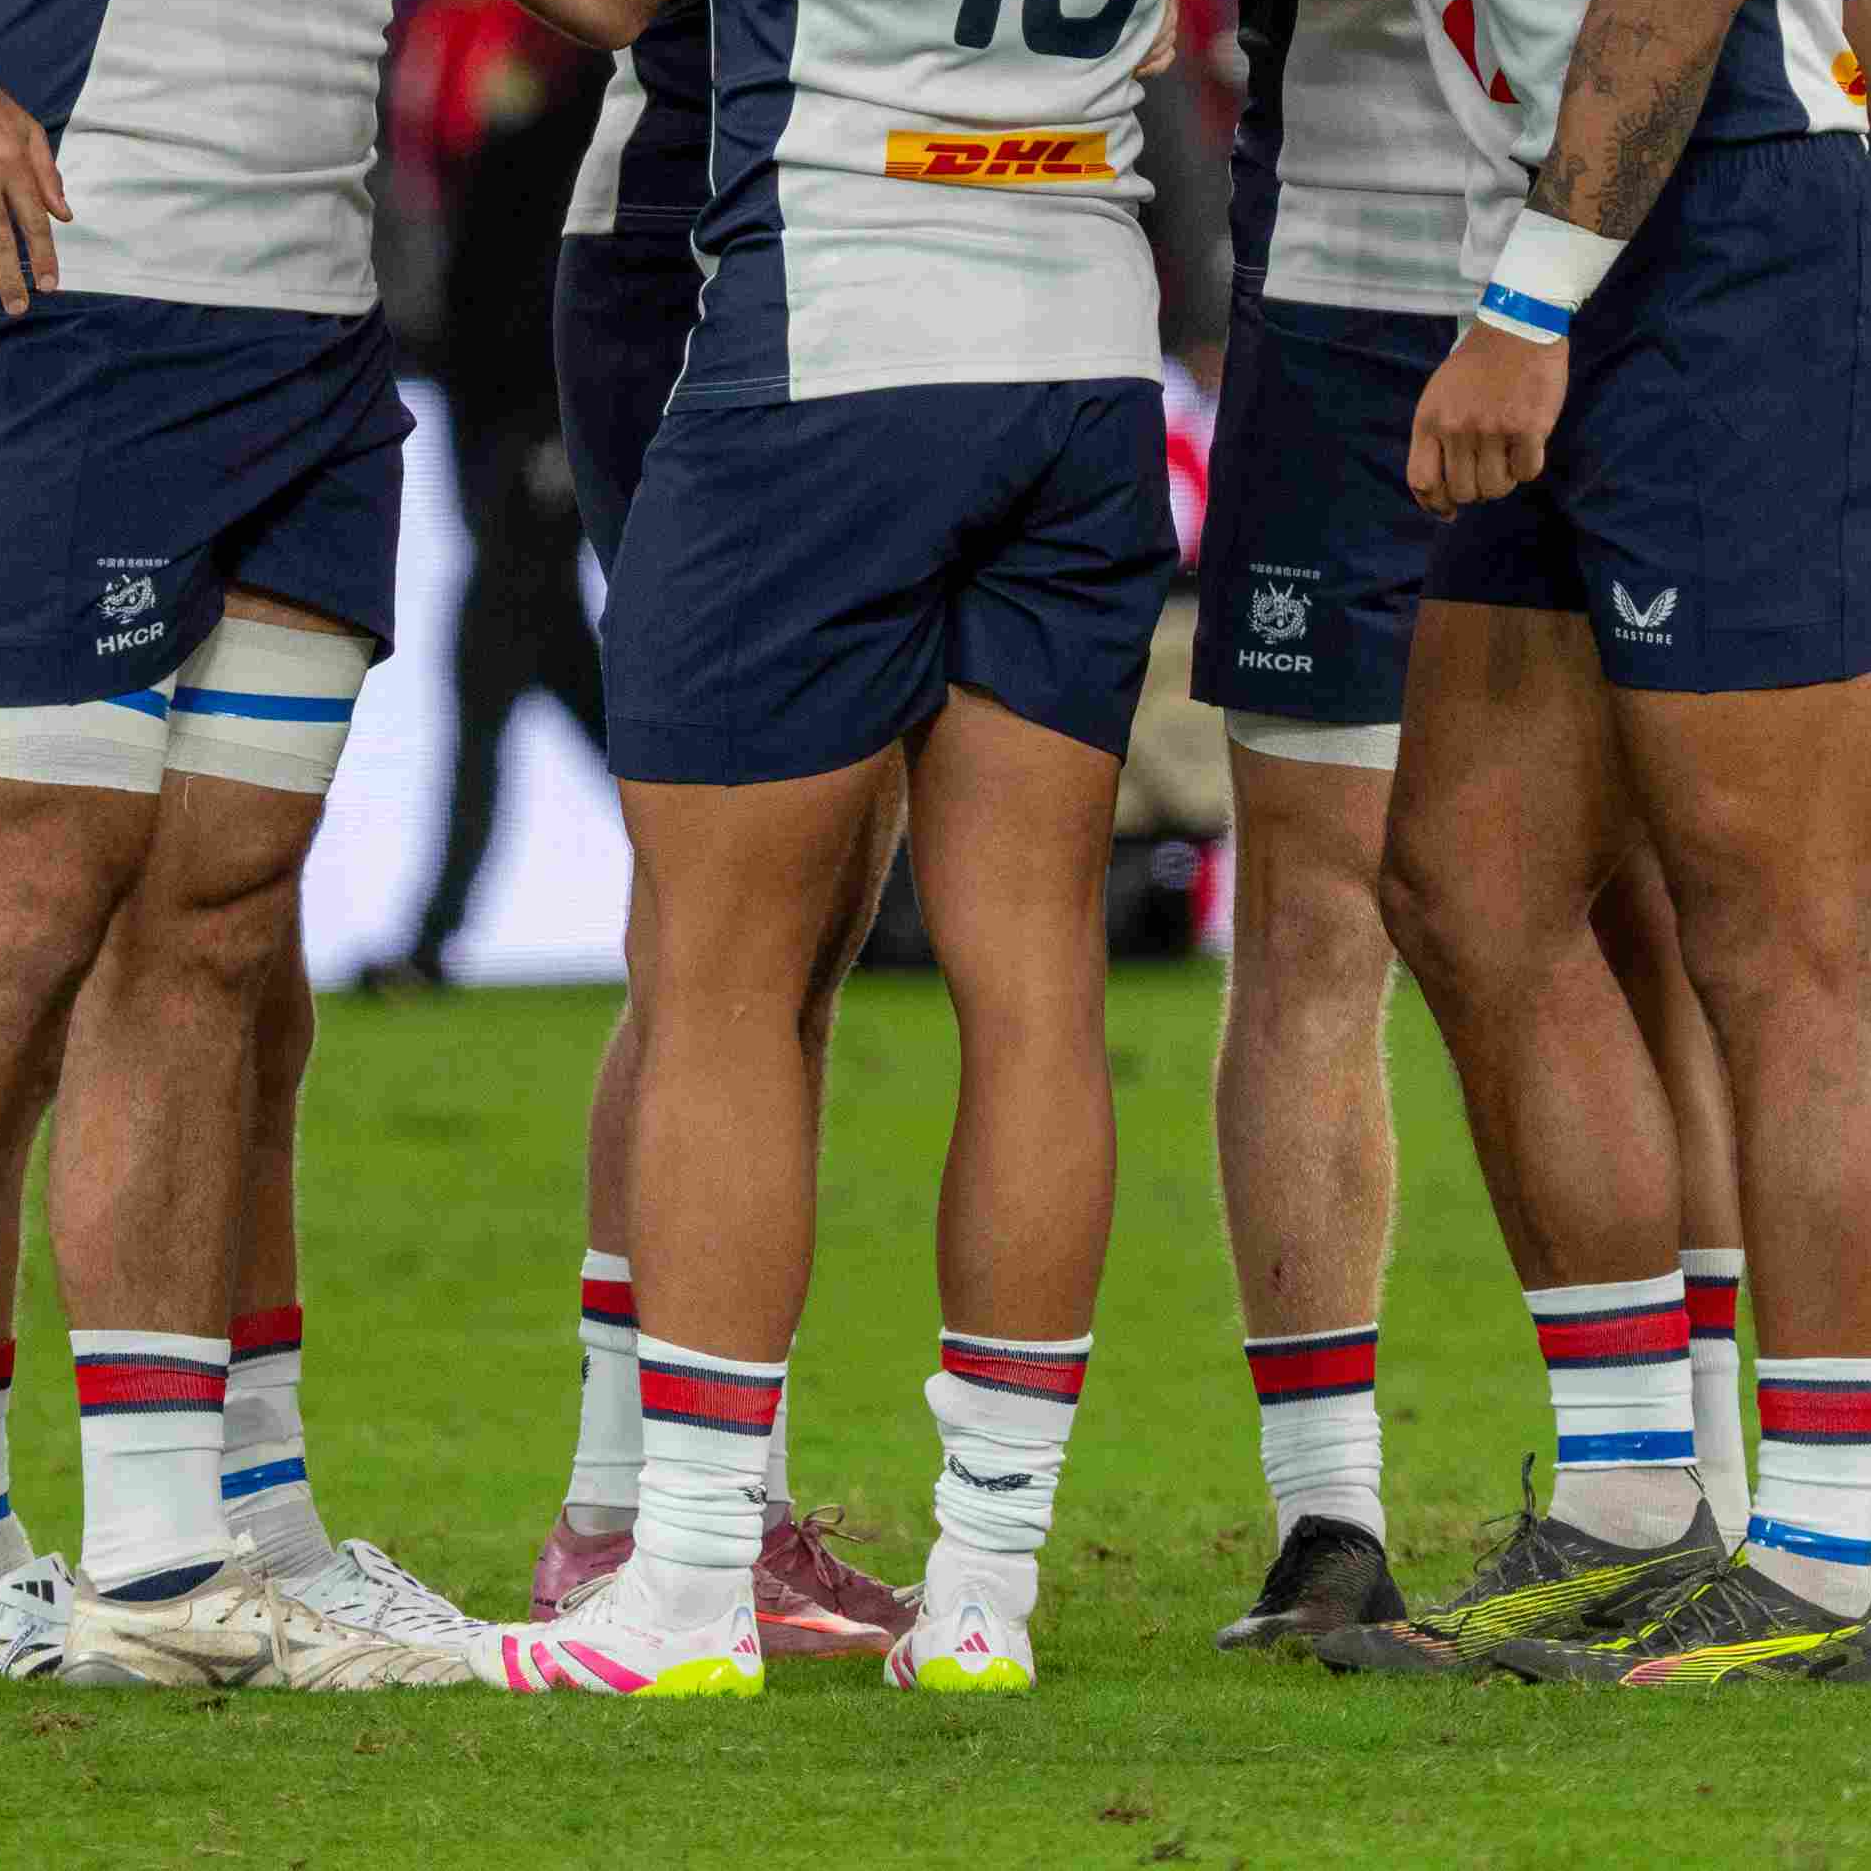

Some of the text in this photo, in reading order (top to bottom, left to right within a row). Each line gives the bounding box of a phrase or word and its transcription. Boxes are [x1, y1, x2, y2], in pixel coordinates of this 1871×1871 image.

[920, 139, 1082, 176] DHL
[96, 621, 165, 656] HKCR
[1614, 626, 1674, 646] CASTORE
[1237, 649, 1314, 674] HKCR
